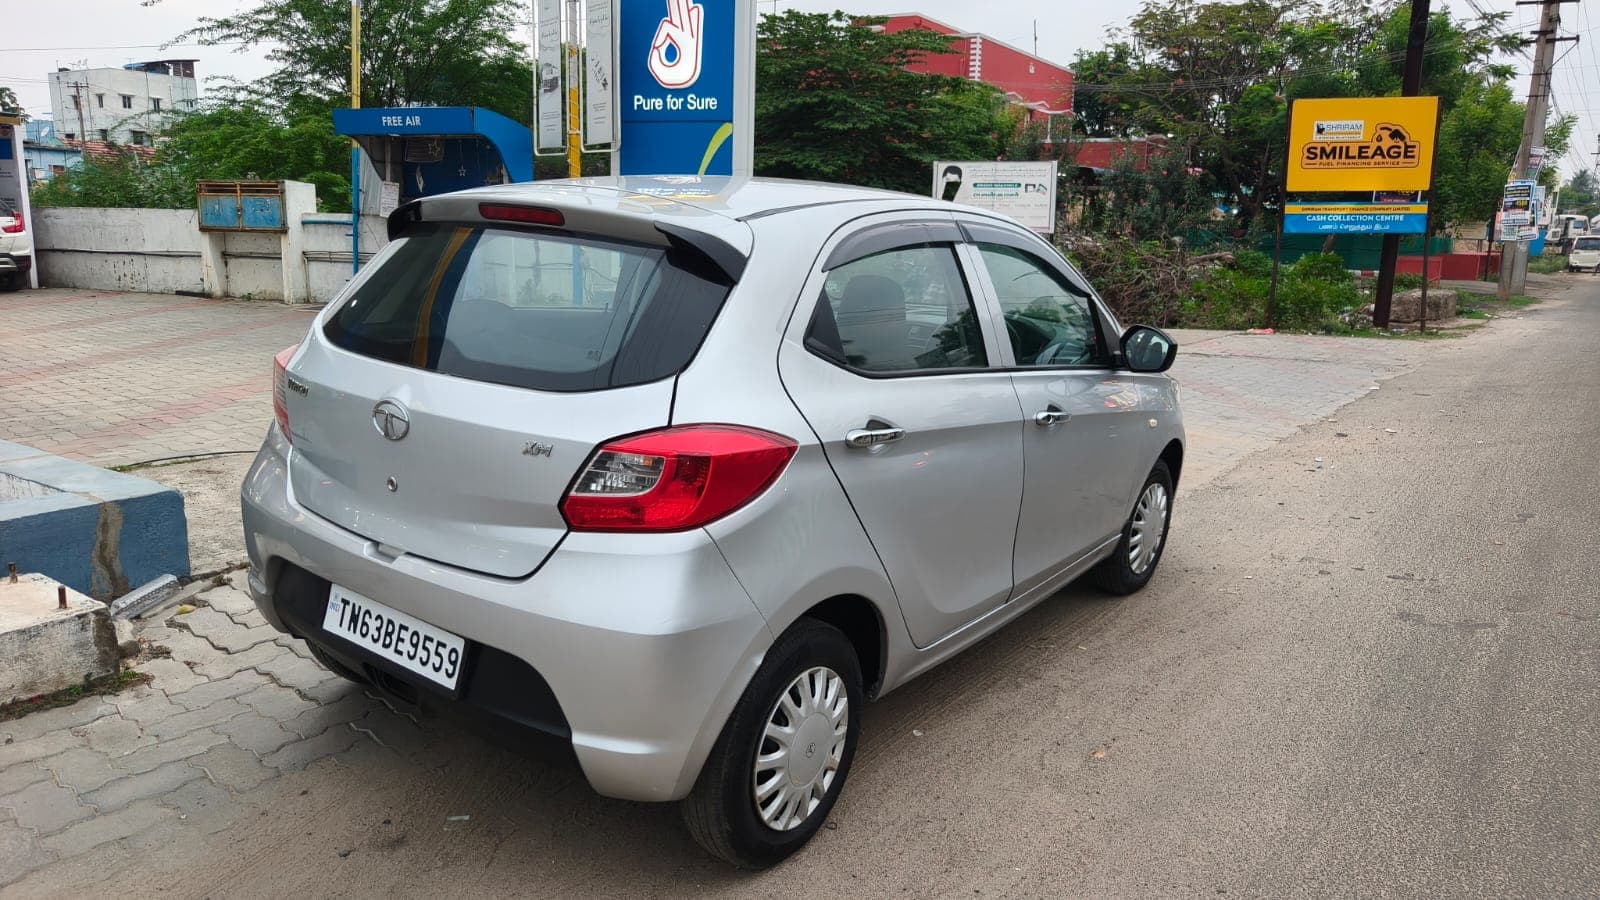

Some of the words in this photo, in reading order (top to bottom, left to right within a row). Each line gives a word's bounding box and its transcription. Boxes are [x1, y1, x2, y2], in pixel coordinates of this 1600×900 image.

[633, 95, 663, 110] Pure
[667, 94, 684, 110] for
[687, 94, 718, 110] Sure
[381, 116, 403, 126] FREE
[405, 115, 422, 126] AIR
[1326, 123, 1362, 131] SHRIRAM
[1306, 144, 1416, 160] SMILEAGE
[338, 597, 460, 679] TN63BE9559
